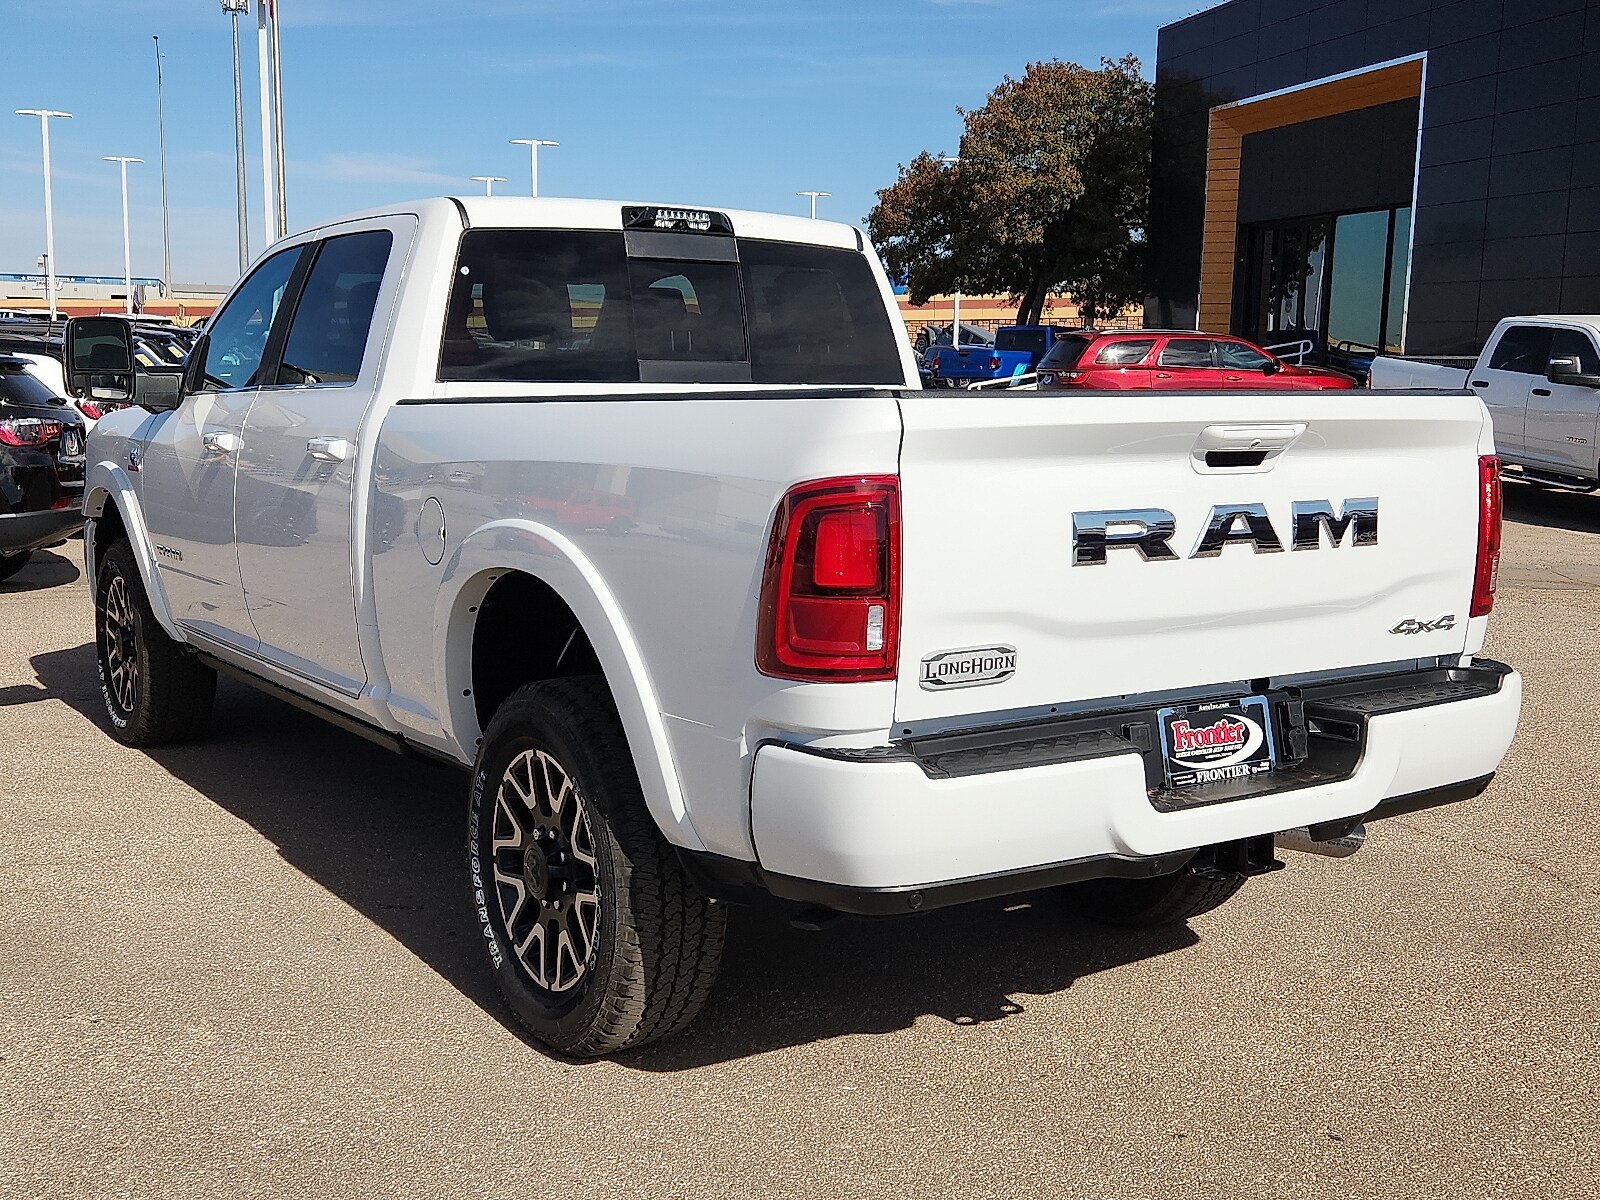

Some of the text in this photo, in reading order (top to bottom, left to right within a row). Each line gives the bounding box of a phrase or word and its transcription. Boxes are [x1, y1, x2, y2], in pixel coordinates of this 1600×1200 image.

[1071, 497, 1379, 567] RAM
[1387, 611, 1457, 635] 4x4
[924, 655, 1016, 679] LONGHORN
[1172, 719, 1245, 751] Frontier
[1196, 763, 1251, 783] FRONTIER
[470, 811, 503, 969] TRANSFORCE
